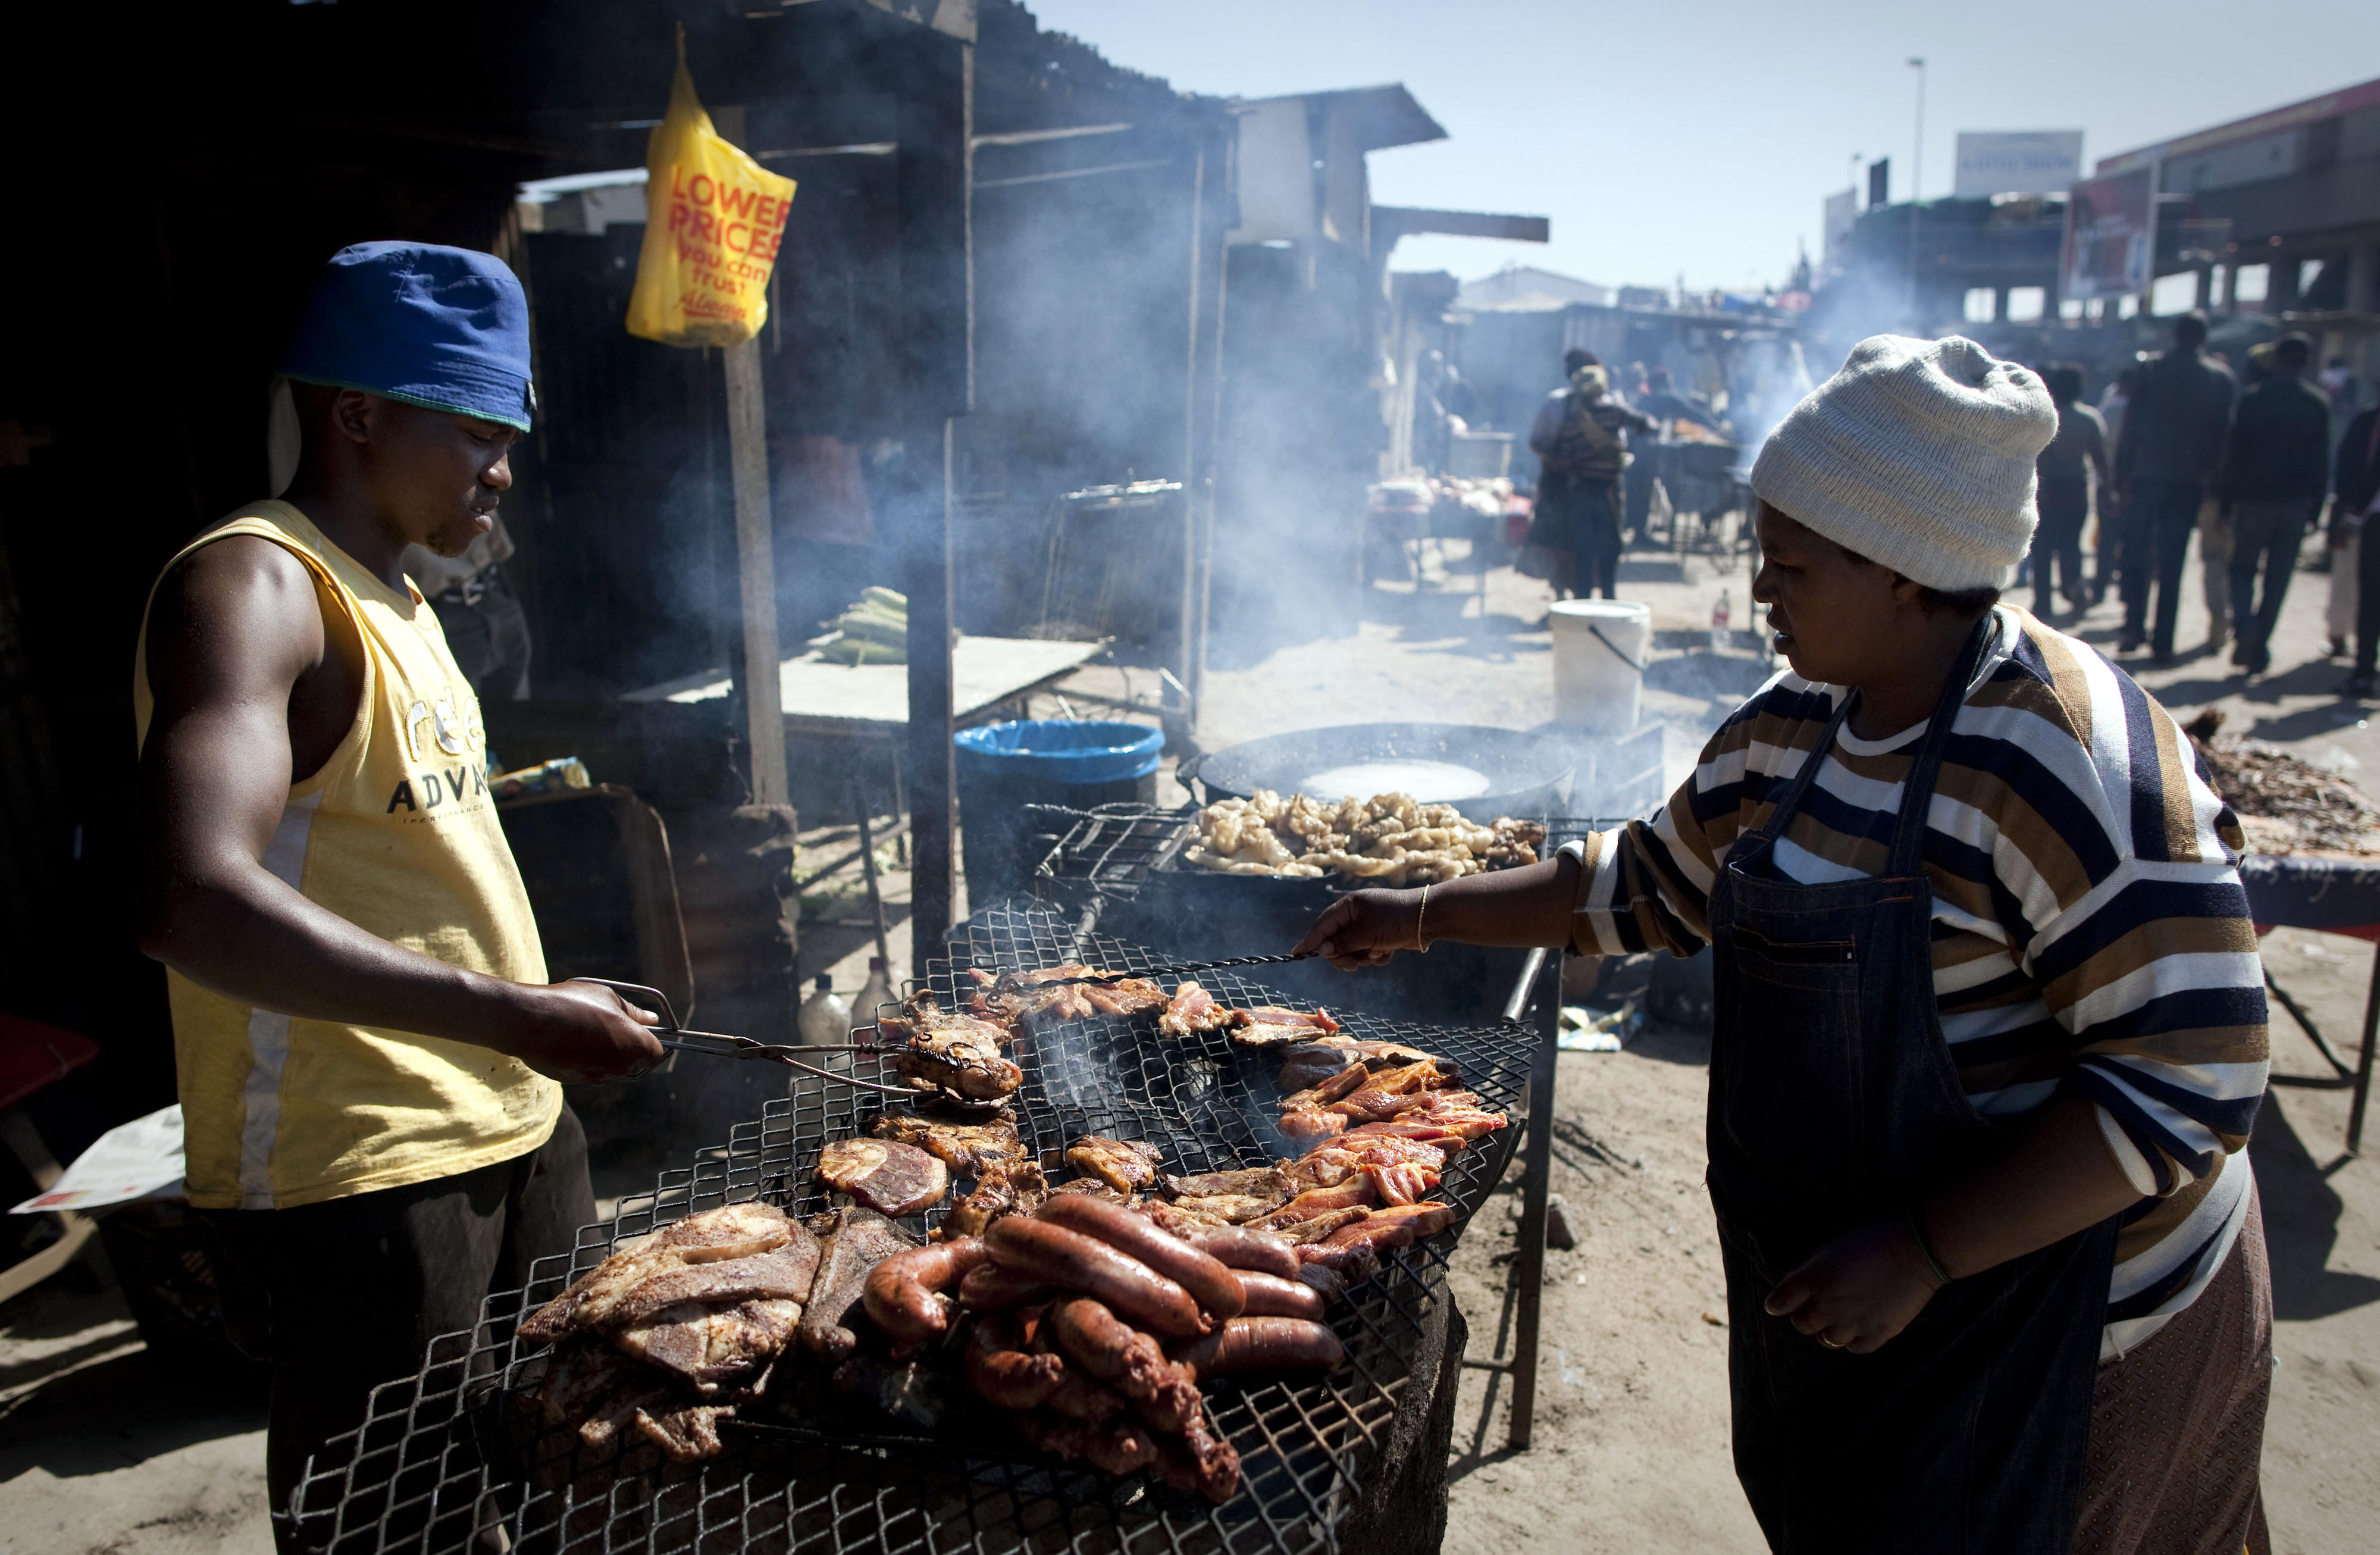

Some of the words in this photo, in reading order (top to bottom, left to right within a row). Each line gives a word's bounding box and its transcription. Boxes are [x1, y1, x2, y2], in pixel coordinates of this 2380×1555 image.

[678, 242, 721, 268] you
[728, 261, 766, 283] can
[693, 267, 746, 295] trust
[387, 763, 488, 814] ADVA
